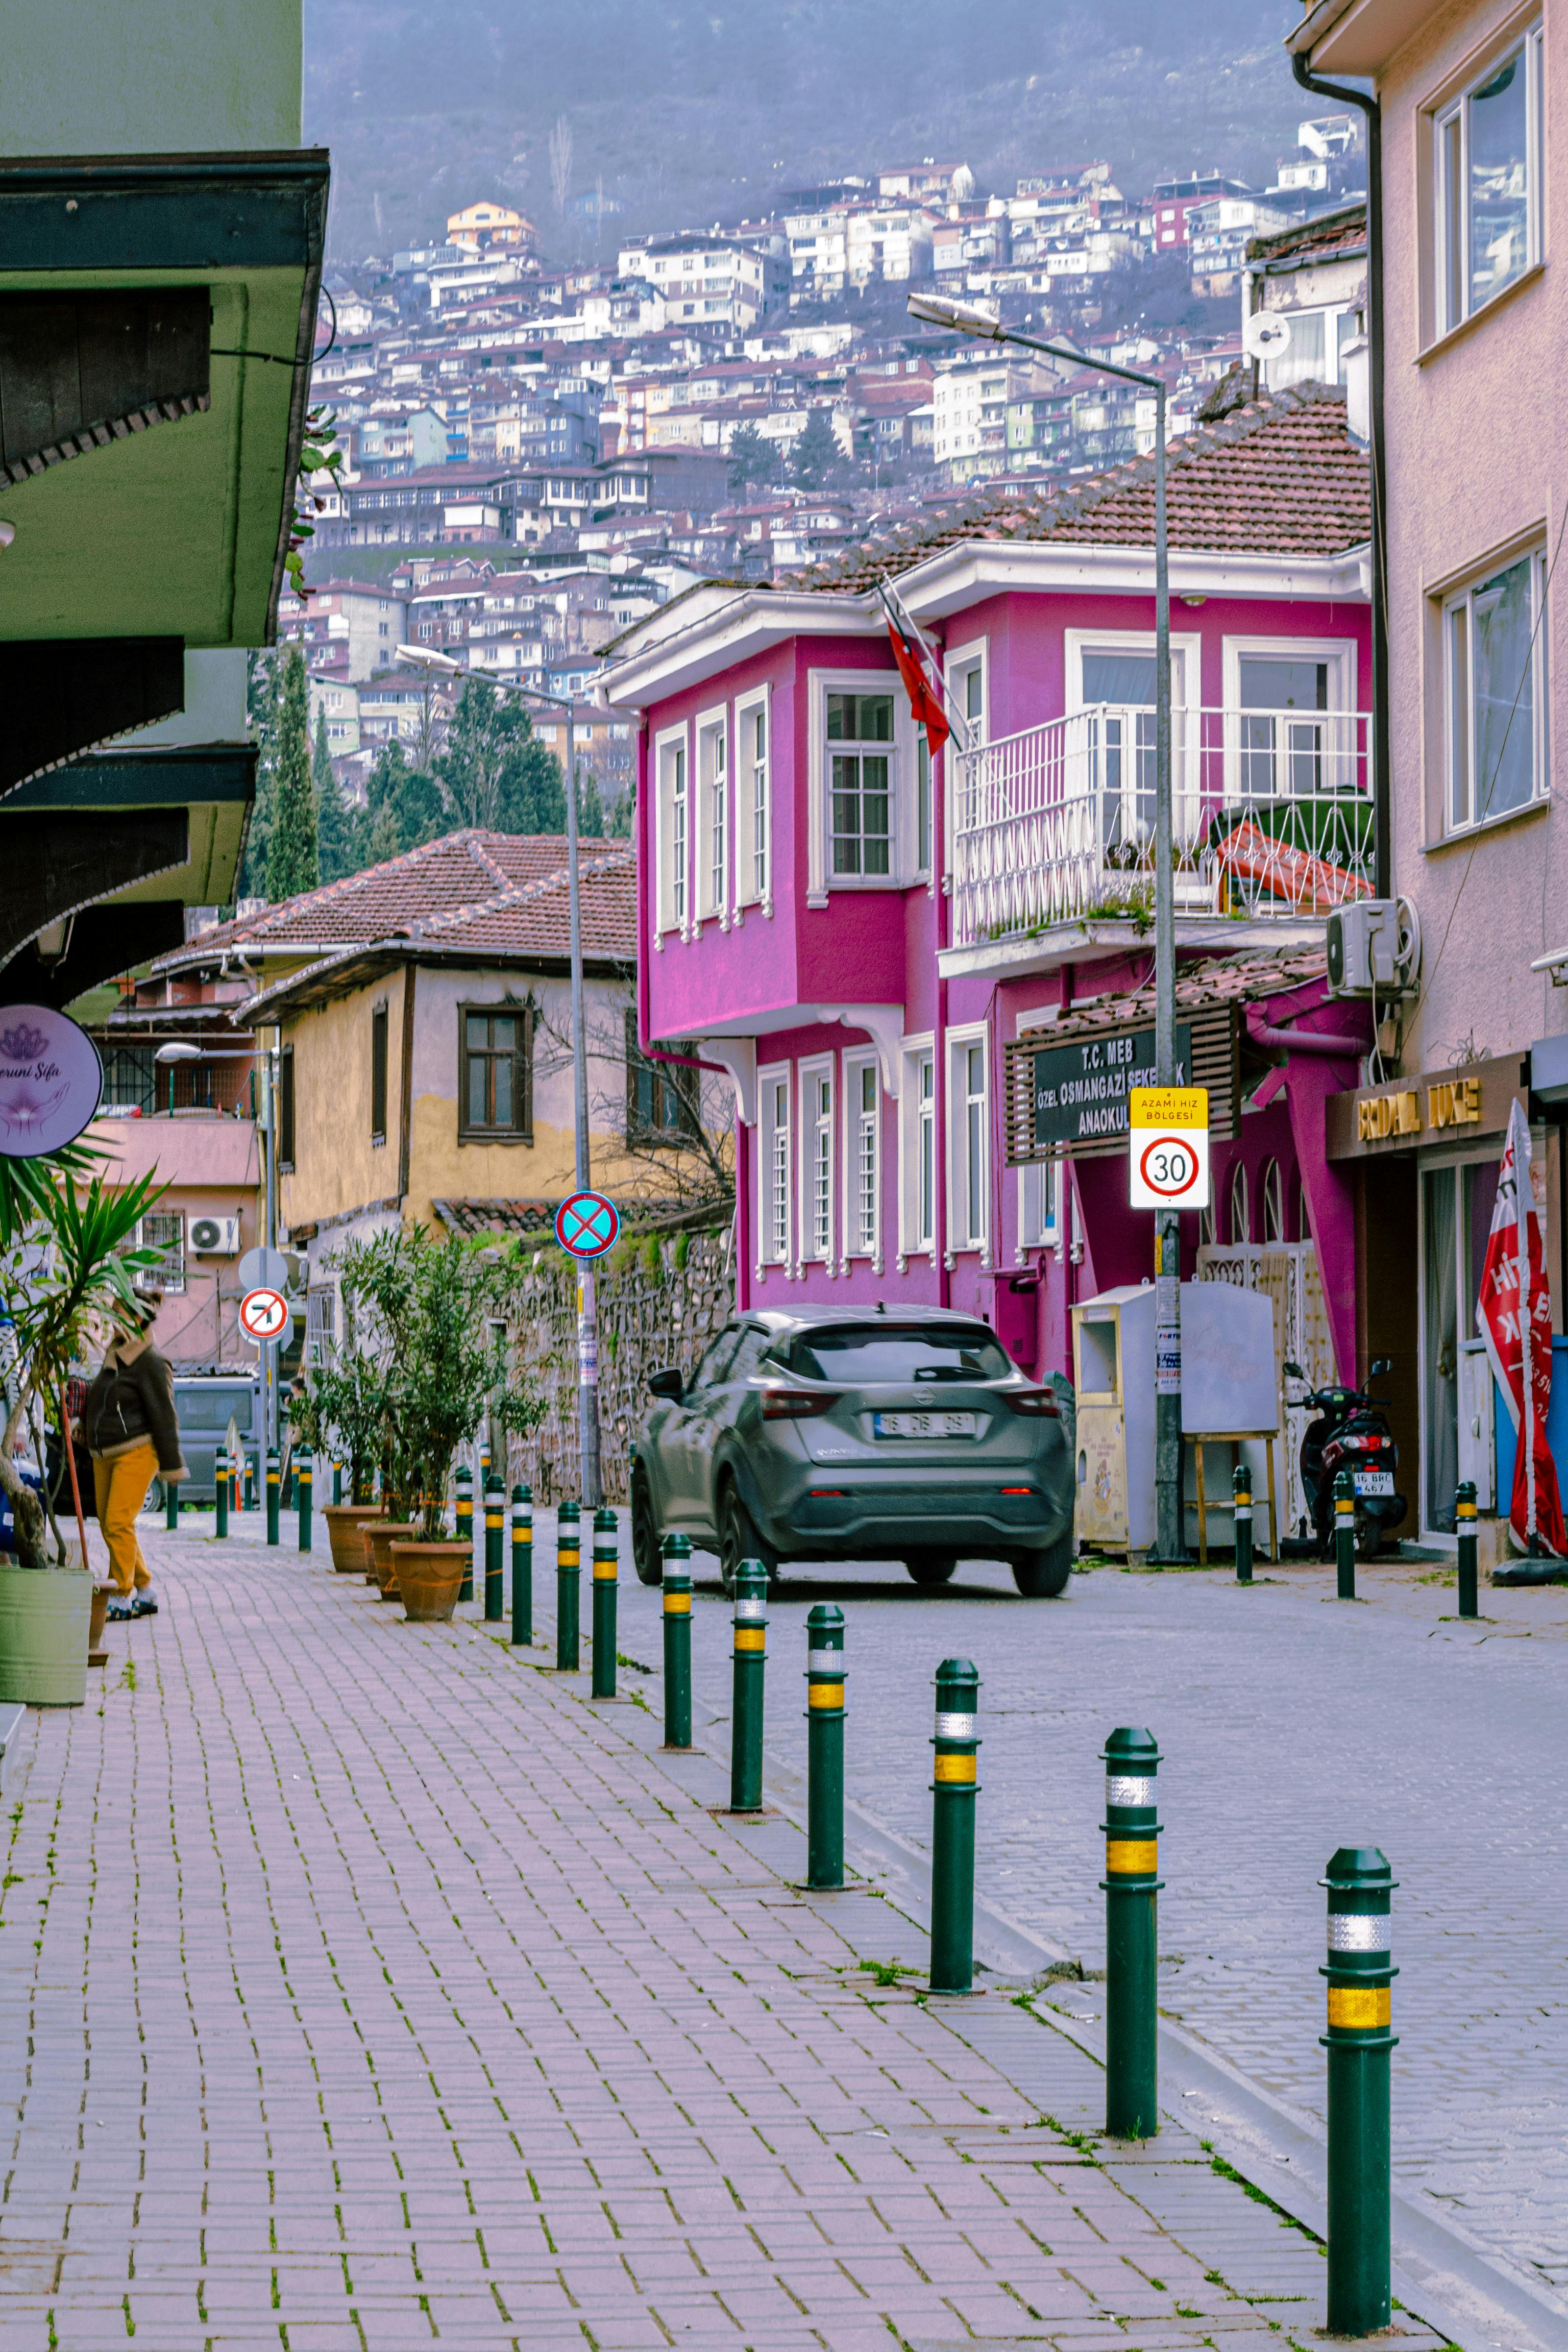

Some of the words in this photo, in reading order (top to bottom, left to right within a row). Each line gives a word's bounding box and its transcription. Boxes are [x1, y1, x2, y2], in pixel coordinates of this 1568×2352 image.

[1082, 1044, 1104, 1071] T.C.
[1107, 1038, 1133, 1066] MEB
[1037, 1087, 1058, 1110] ÖZEL
[1060, 1066, 1126, 1106] OSMANGAZİ
[1141, 1098, 1175, 1108] AZAMİ
[1146, 1110, 1193, 1120] BÖLGESİ
[1358, 1090, 1421, 1141] BRIDAL
[1154, 1154, 1186, 1182] 30
[1357, 1474, 1367, 1482] 16
[1371, 1473, 1391, 1482] BRC
